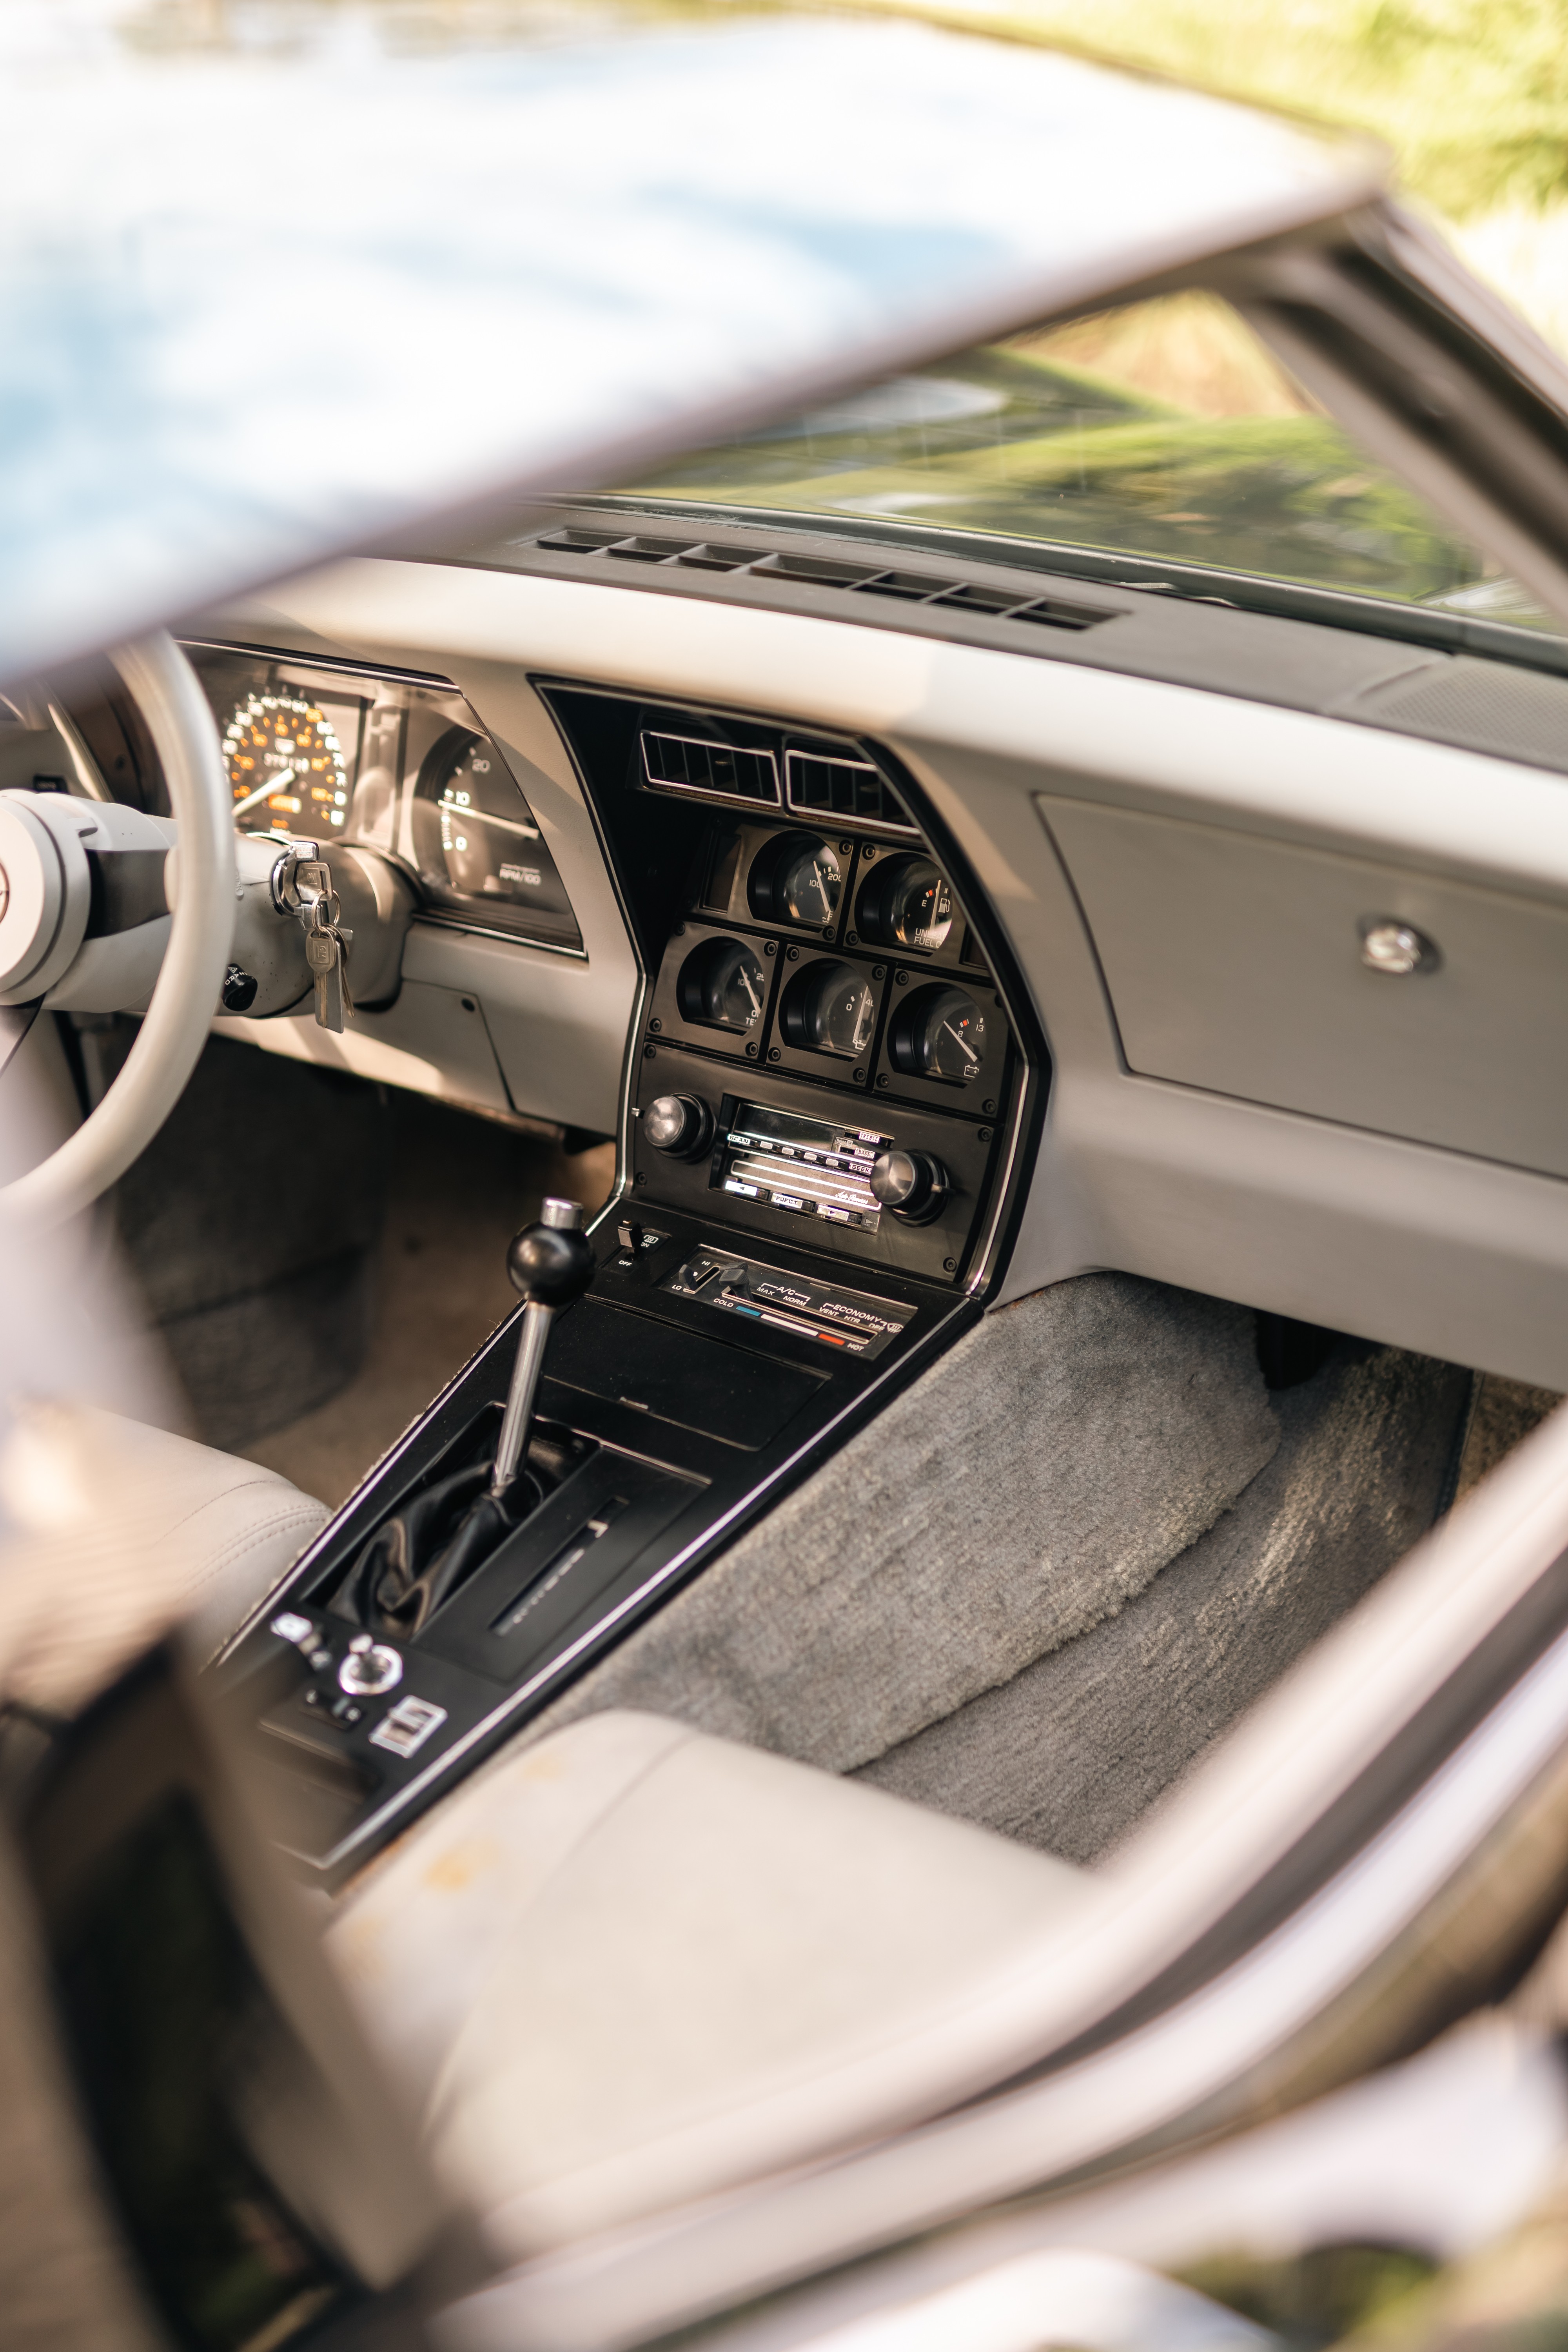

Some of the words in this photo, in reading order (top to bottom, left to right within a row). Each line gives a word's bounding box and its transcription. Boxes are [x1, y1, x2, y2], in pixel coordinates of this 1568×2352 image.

[472, 759, 490, 773] 20
[456, 791, 470, 806] 10
[455, 836, 467, 851] 0
[914, 936, 934, 947] FUEL
[319, 945, 327, 959] GM
[861, 1133, 878, 1142] TREBLE
[776, 1197, 798, 1205] EJECT
[757, 1287, 775, 1296] MAX
[783, 1296, 807, 1306] NORM
[777, 1286, 796, 1295] A/C
[713, 1298, 734, 1307] COLD
[819, 1307, 839, 1316] VENT
[833, 1304, 882, 1323] ECONOMY
